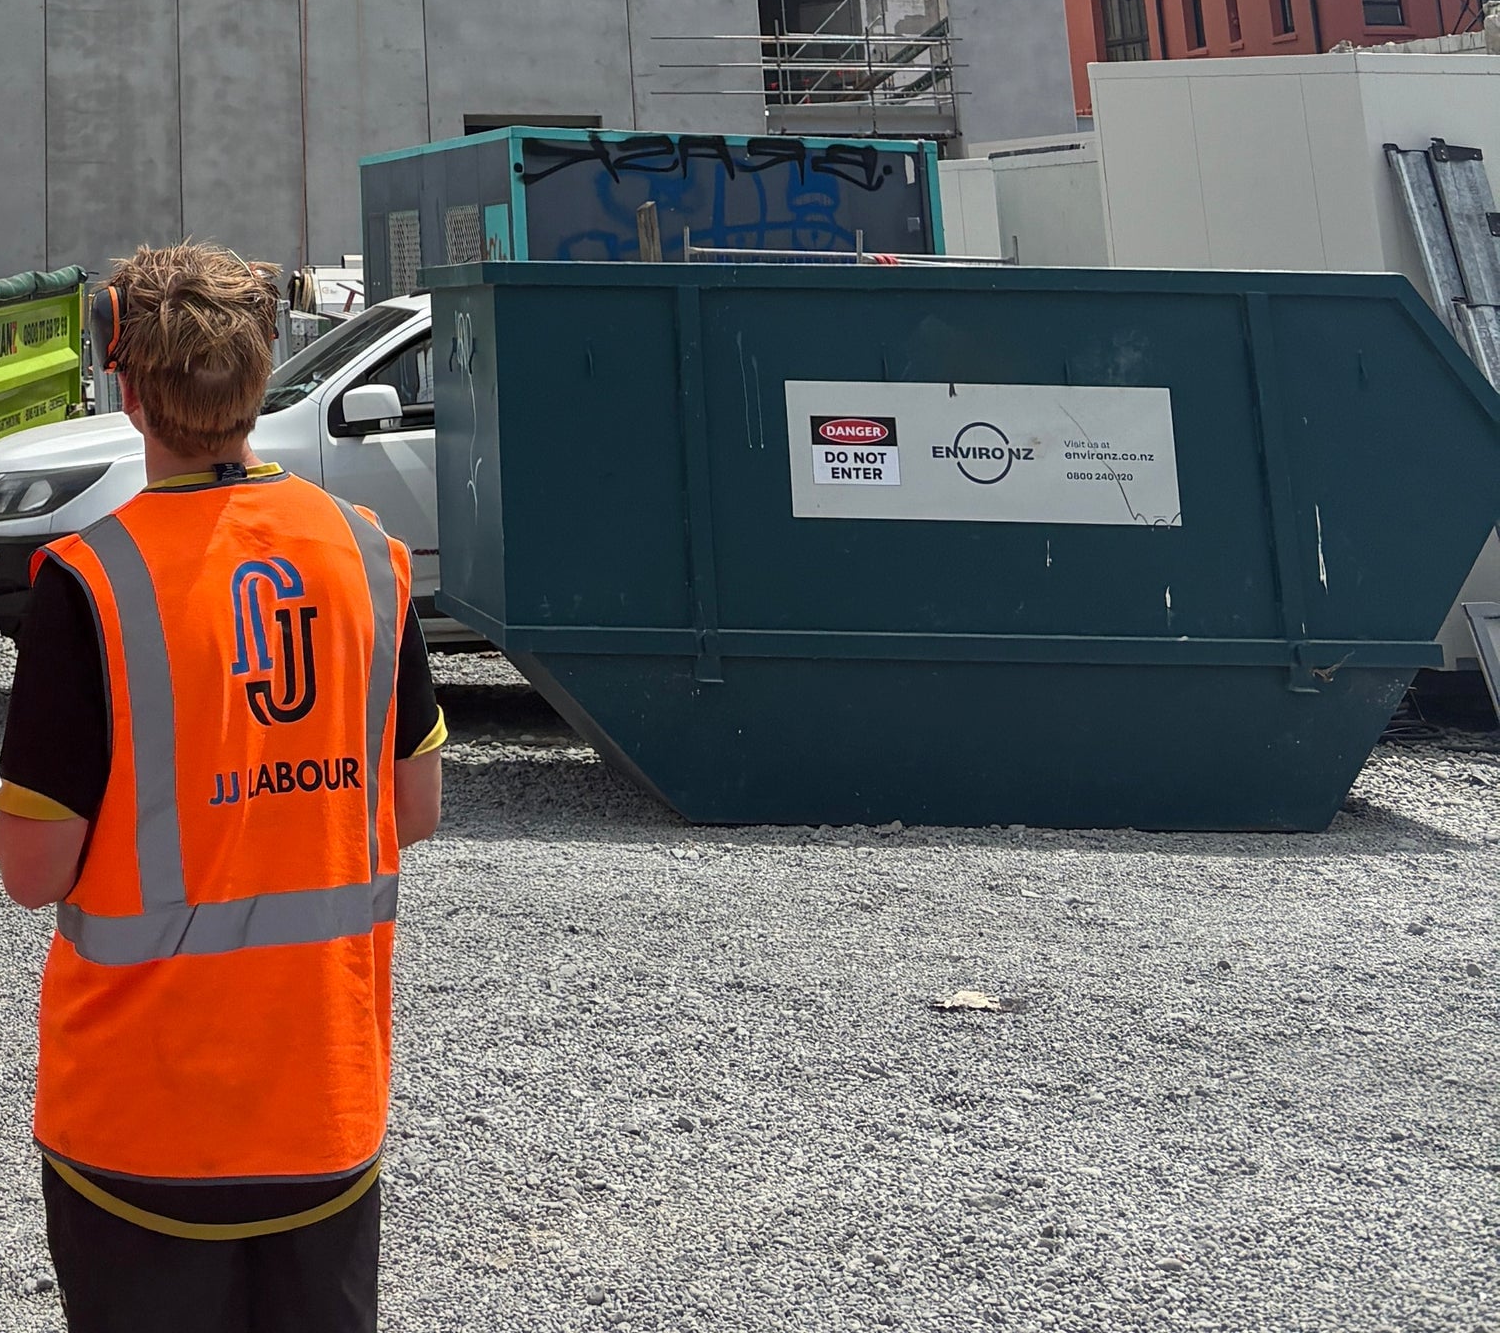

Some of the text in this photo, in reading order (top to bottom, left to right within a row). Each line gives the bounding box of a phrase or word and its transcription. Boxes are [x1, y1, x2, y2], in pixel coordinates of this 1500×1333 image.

[826, 425, 882, 437] DANGER
[1064, 440, 1110, 450] Visit us at
[824, 451, 887, 464] DO NOT
[1064, 451, 1155, 462] environz.co.nz
[831, 467, 883, 480] ENTER
[1066, 471, 1134, 482] 0800 240 120
[209, 757, 363, 805] JJ LABOUR
